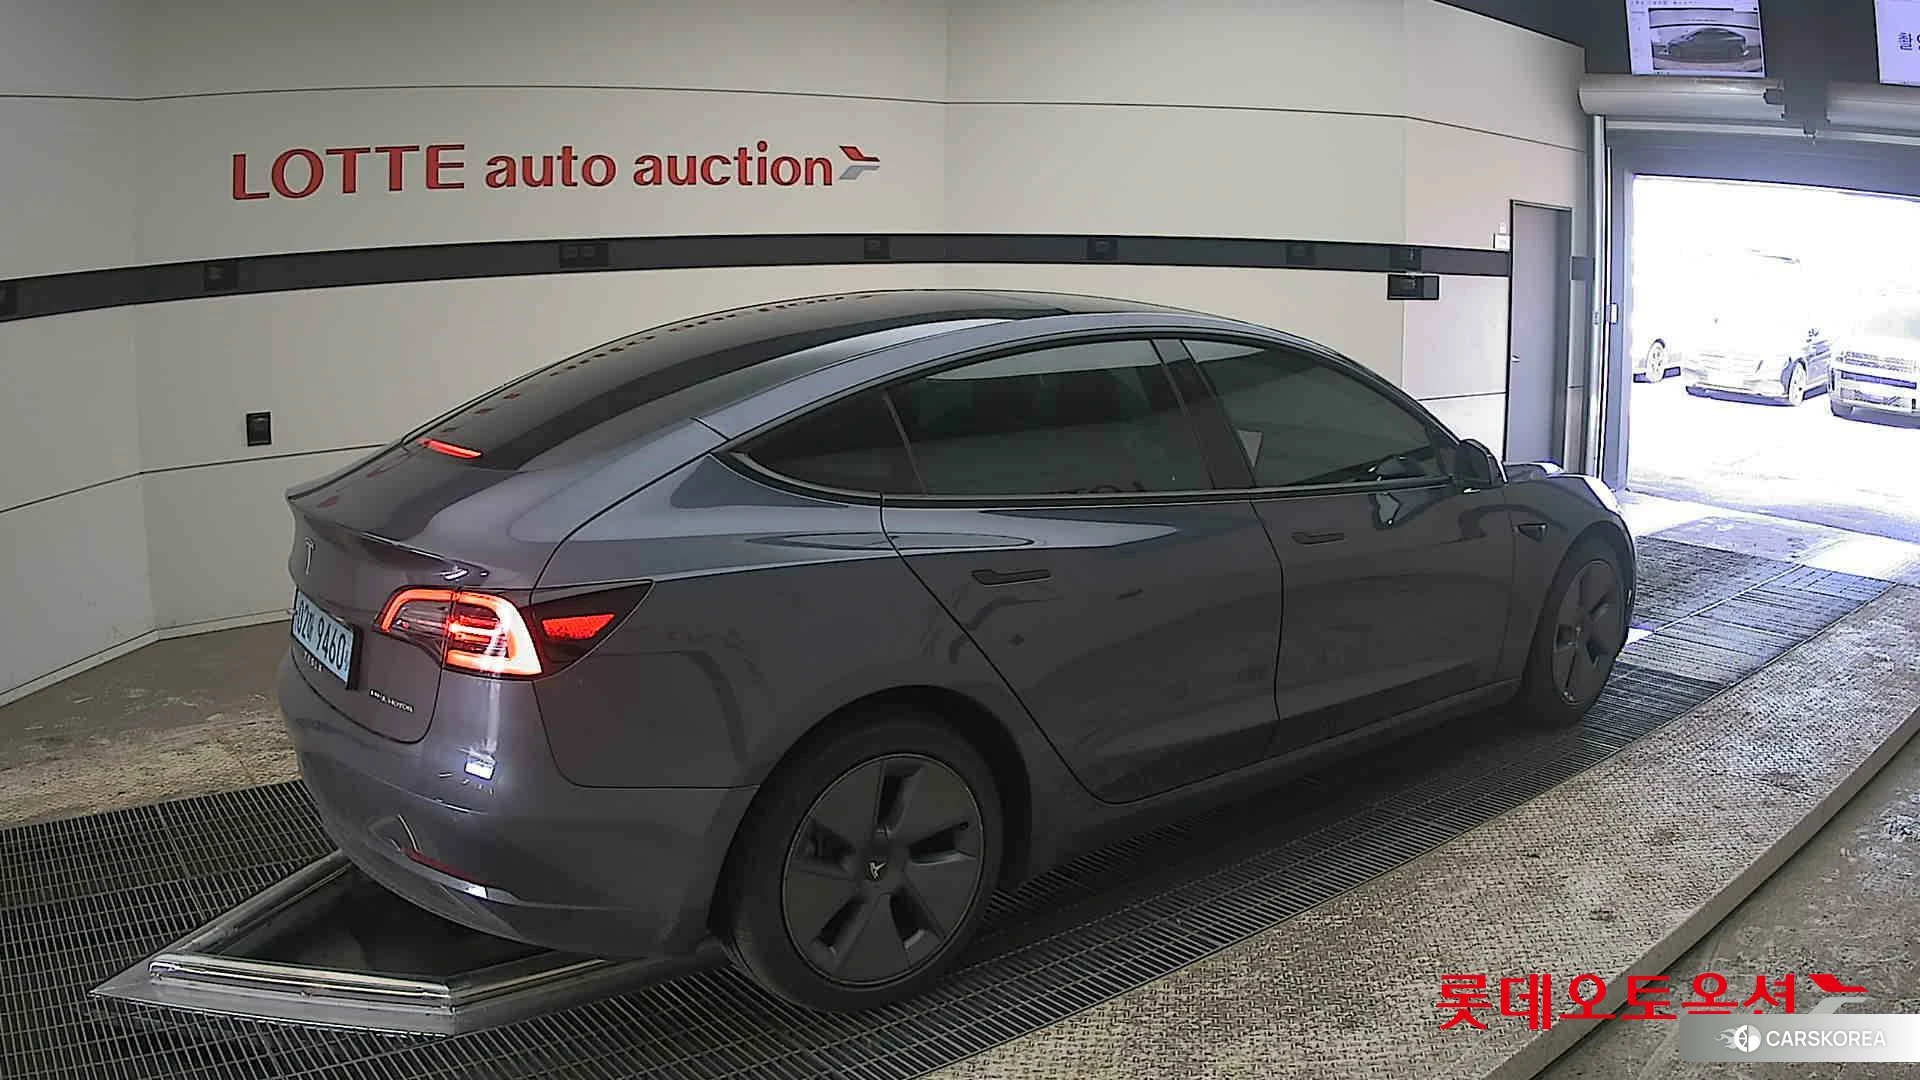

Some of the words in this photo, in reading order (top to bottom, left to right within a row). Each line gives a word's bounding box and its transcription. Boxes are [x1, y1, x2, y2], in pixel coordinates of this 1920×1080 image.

[232, 144, 465, 201] LOTTE
[486, 145, 618, 189] auto
[633, 140, 834, 187] auction
[316, 616, 347, 670] 9460
